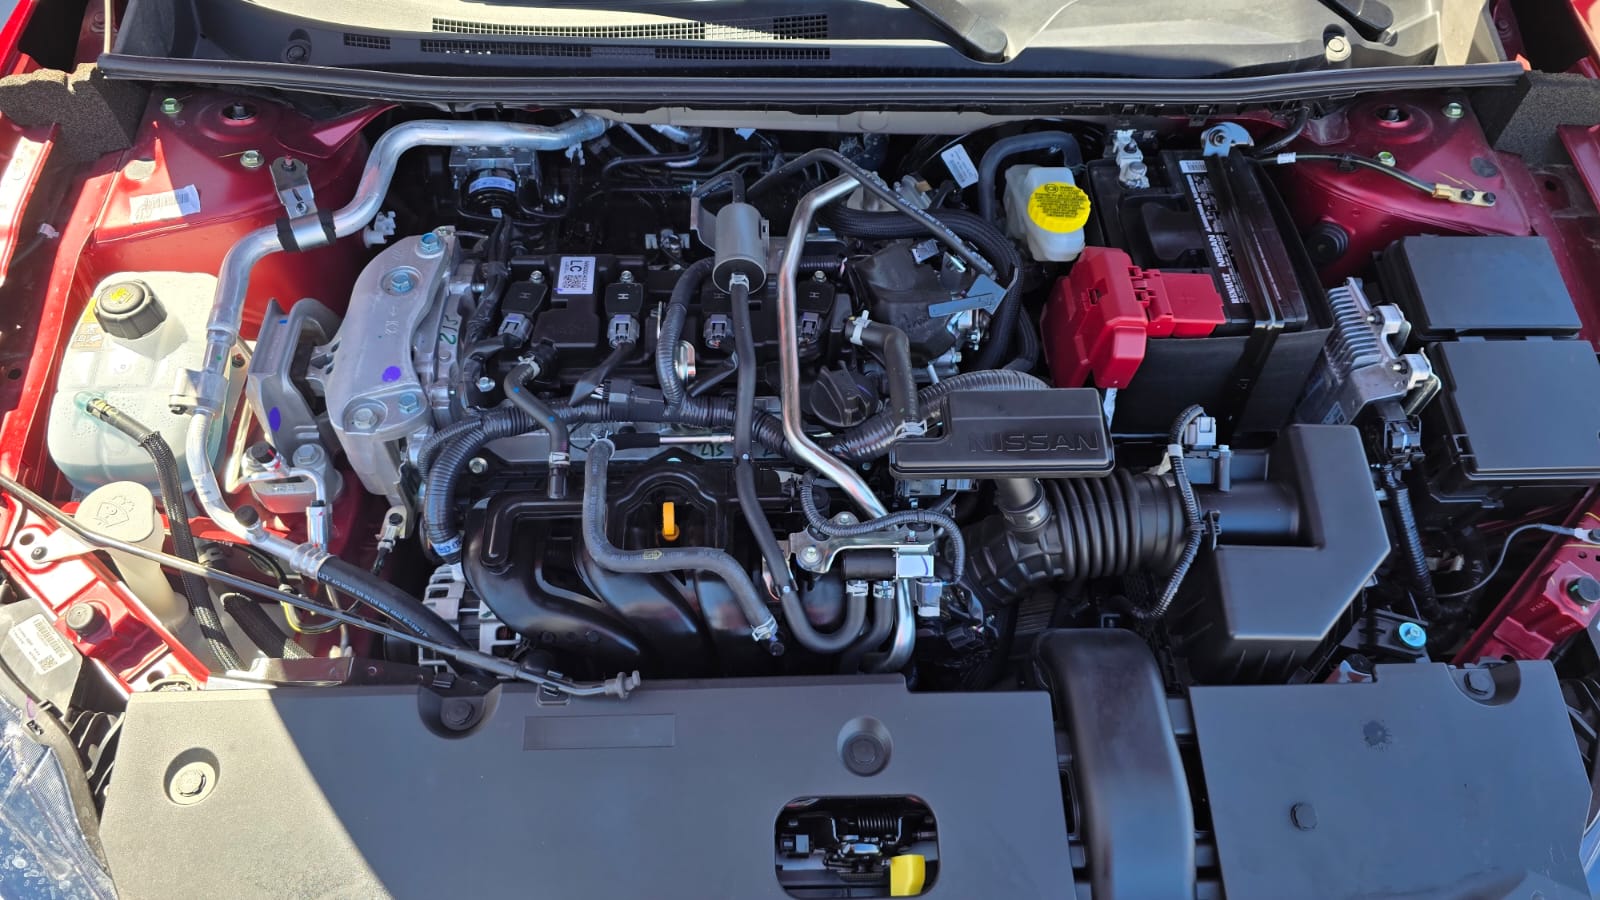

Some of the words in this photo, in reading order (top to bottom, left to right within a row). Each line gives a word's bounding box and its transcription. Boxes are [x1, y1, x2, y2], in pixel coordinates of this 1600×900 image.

[1207, 234, 1226, 268] NISSAN
[569, 260, 583, 273] LC
[968, 431, 1099, 452] NISSAN
